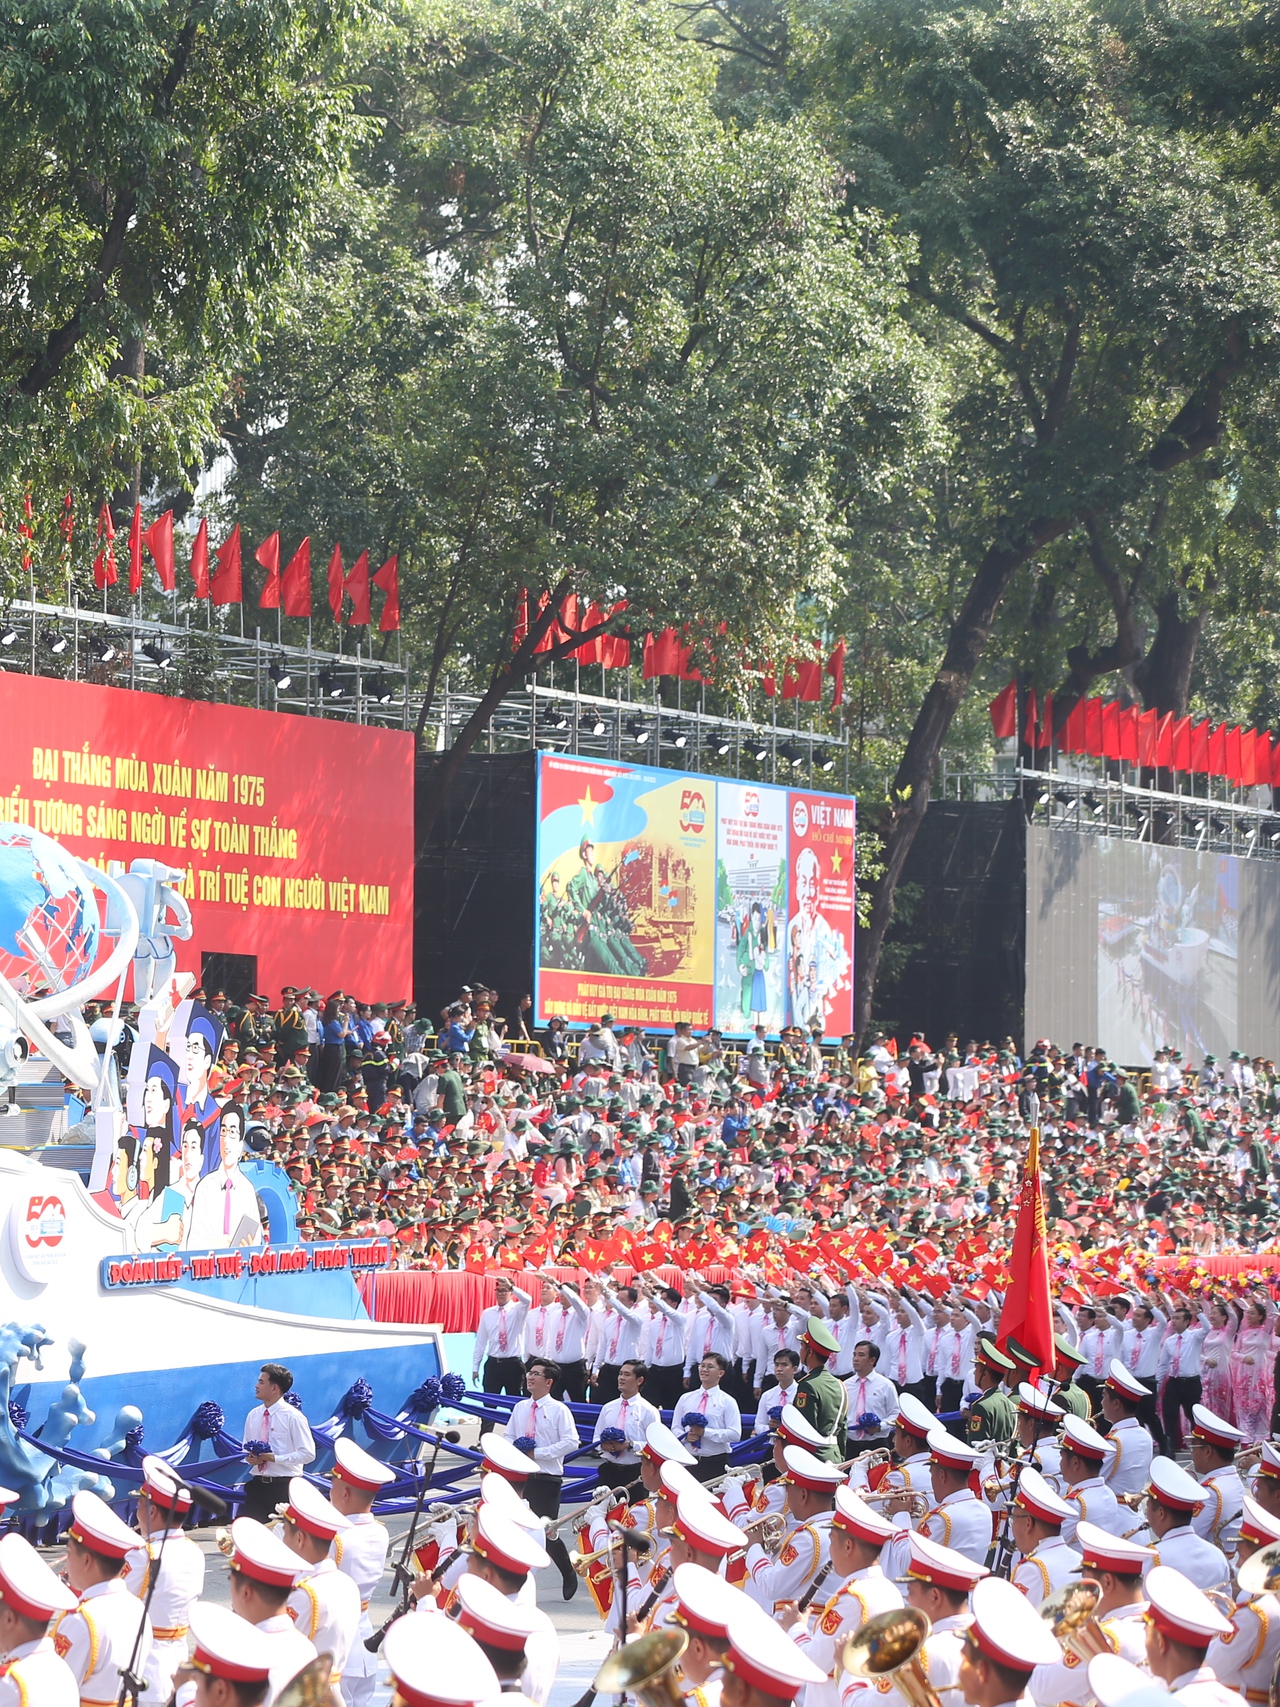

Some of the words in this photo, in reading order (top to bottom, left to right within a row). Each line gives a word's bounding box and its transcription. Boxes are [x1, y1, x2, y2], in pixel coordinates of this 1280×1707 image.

[32, 747, 58, 788] ĐẠI
[62, 741, 111, 788] THẮNG
[115, 753, 148, 793] MÙA
[152, 759, 192, 798] XUÂN
[196, 763, 228, 803] NĂM
[232, 774, 265, 807] 1975
[33, 798, 83, 841] TƯỢNG
[86, 800, 127, 841] SÁNG
[131, 805, 166, 846] NGỜI
[169, 807, 187, 848] VỀ
[191, 817, 212, 857] SỰ
[214, 817, 250, 854] TOÀN
[253, 816, 297, 859] THẮNG
[811, 800, 831, 829] VIỆT
[833, 807, 853, 829] NAM
[812, 828, 822, 842] HỒ
[823, 831, 834, 843] CHÍ
[835, 834, 852, 846] MINH
[199, 865, 221, 902] TRÍ
[224, 868, 249, 911] TUỆ
[253, 875, 281, 907] CON
[285, 873, 325, 911] NGƯỜI
[329, 877, 356, 918] VIỆT
[359, 884, 389, 915] NAM
[109, 1252, 155, 1284] ĐOÀN
[155, 1252, 182, 1281] KẾT
[191, 1251, 215, 1279] TRÍ
[216, 1250, 242, 1279] TUỆ
[279, 1245, 308, 1272] MỚI
[314, 1243, 349, 1269] PHÁT
